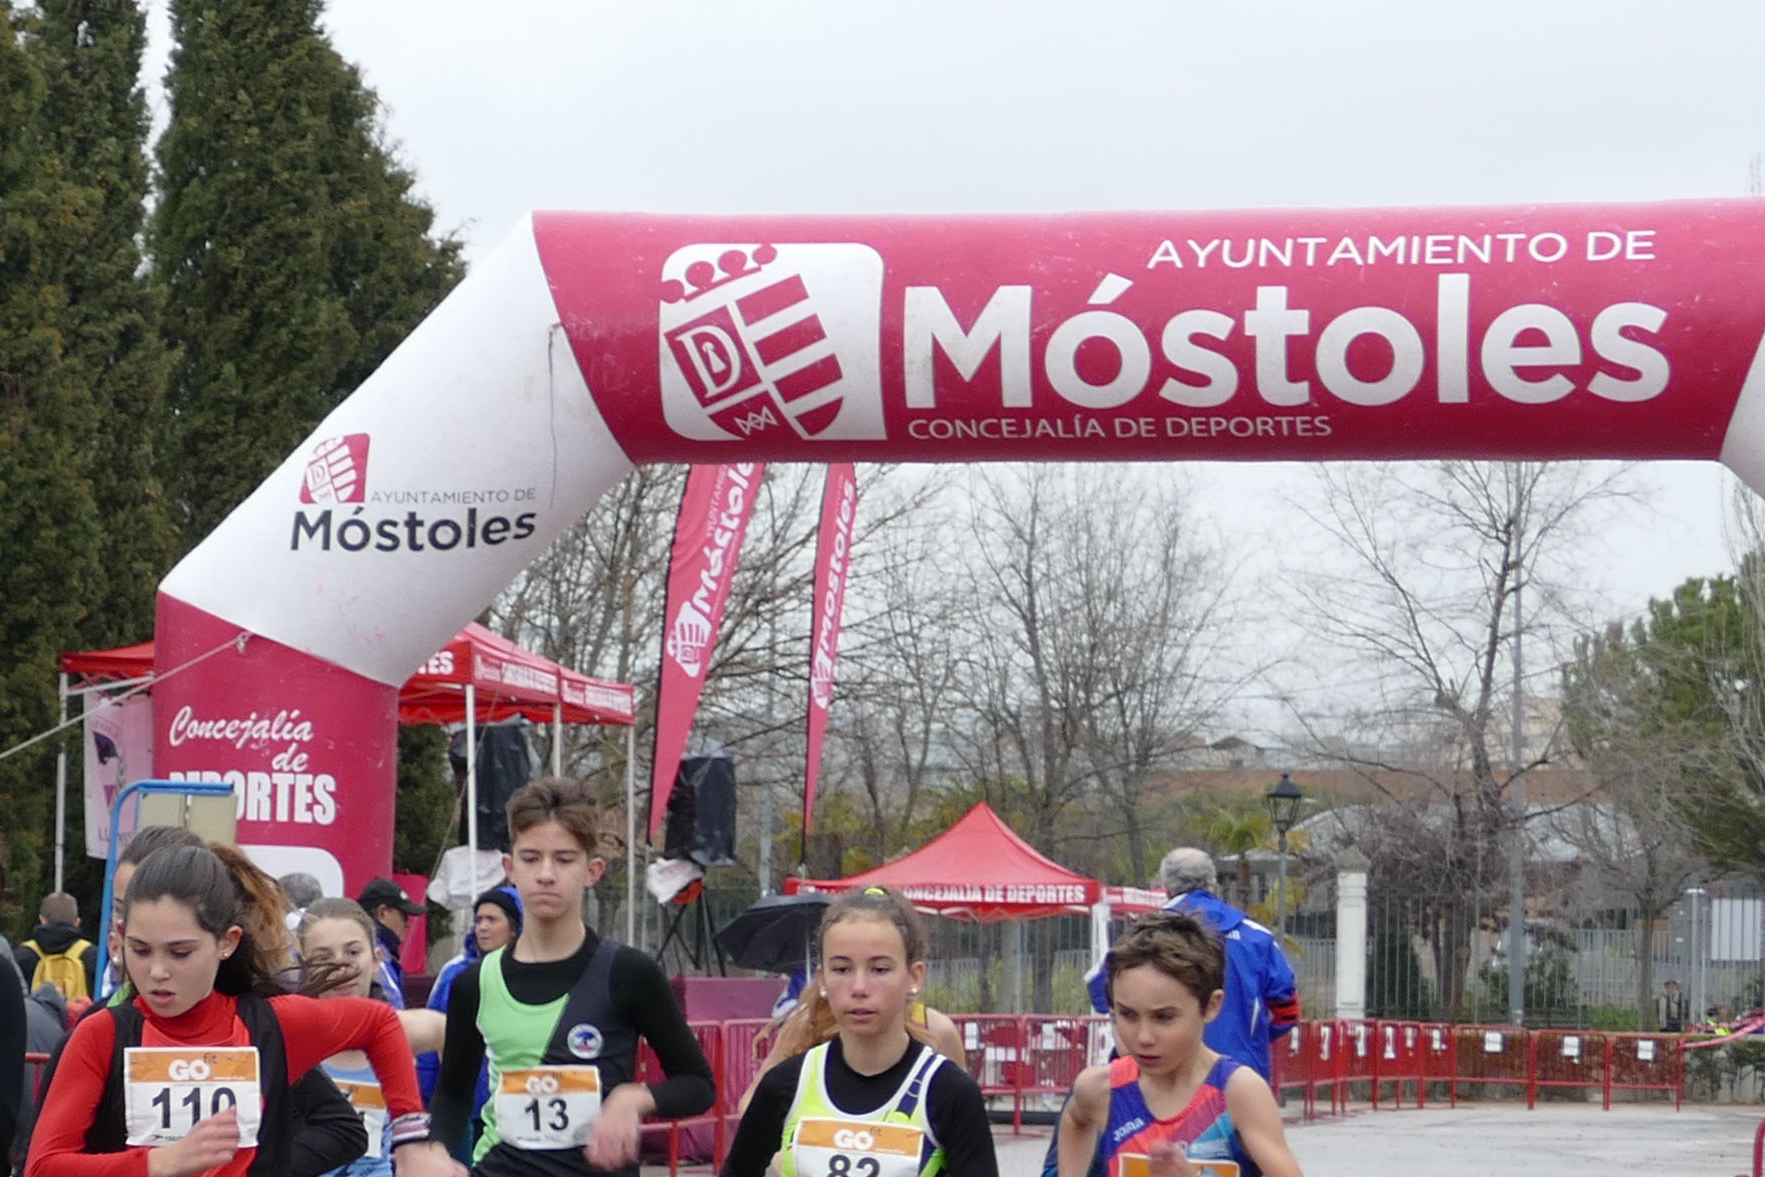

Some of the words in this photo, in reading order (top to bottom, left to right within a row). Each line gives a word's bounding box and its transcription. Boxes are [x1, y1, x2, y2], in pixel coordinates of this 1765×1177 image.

[1147, 232, 1568, 268] AYUNTAMIENTO
[1587, 230, 1657, 261] DE
[903, 272, 1671, 410] Móstoles
[907, 411, 1108, 441] CONCEJALÍA
[1115, 416, 1157, 438] DE
[1166, 414, 1333, 439] DEPORTES
[370, 489, 510, 505] AYUNTAMIENTO
[514, 486, 537, 501] DE
[290, 505, 538, 552] Móstoles
[168, 705, 314, 750] Concejalía
[271, 741, 310, 773] de
[169, 770, 337, 825] ORTES
[985, 884, 1005, 903] DE
[1007, 884, 1086, 904] DEPORTES
[168, 1058, 211, 1081] GO
[524, 1097, 569, 1132] 13
[833, 1128, 875, 1151] GO
